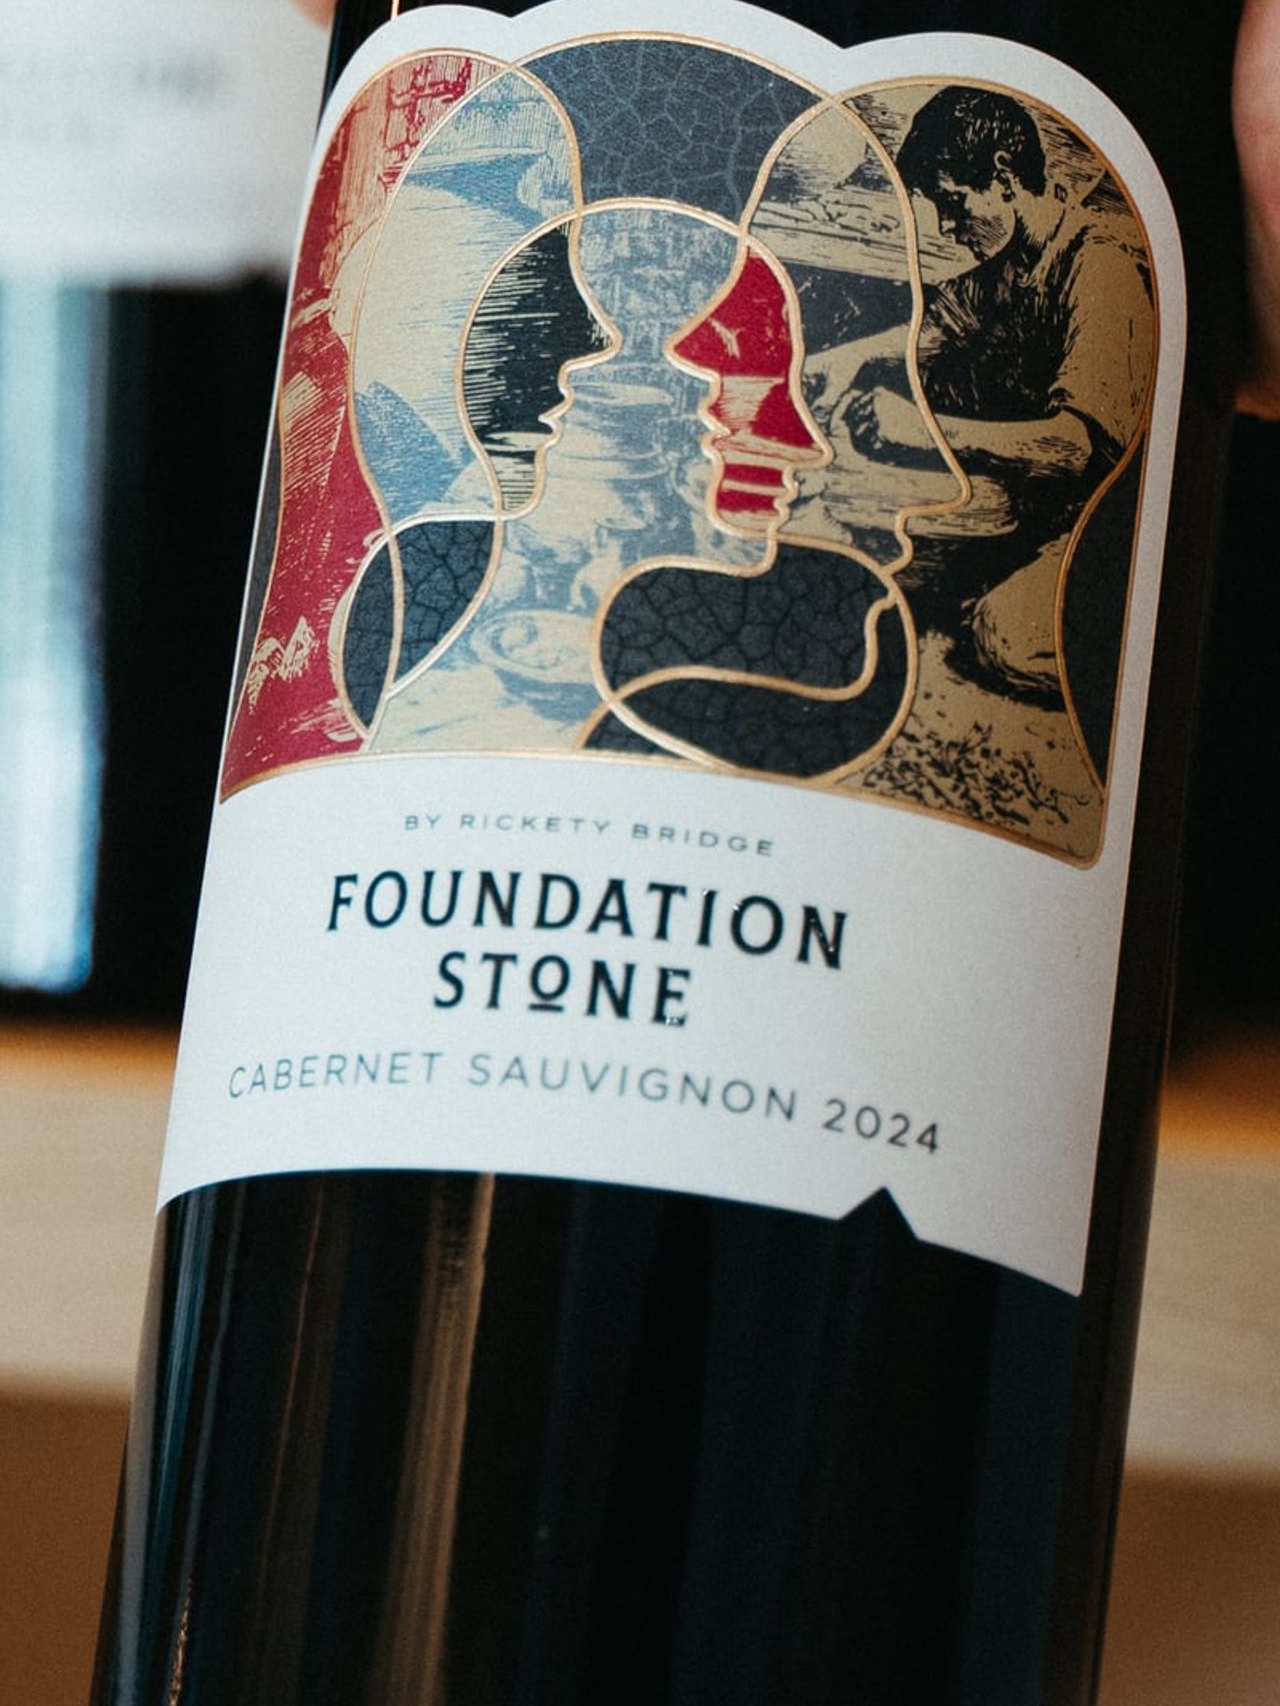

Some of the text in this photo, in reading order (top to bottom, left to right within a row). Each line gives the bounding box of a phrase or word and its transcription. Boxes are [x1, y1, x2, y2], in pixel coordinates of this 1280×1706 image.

[405, 814, 774, 857] BY RICKETY BRIDGE
[326, 870, 848, 970] FOUNDATION
[433, 951, 691, 1028] STONE
[229, 1052, 940, 1155] CABERNET SAUVIGNON 2024
